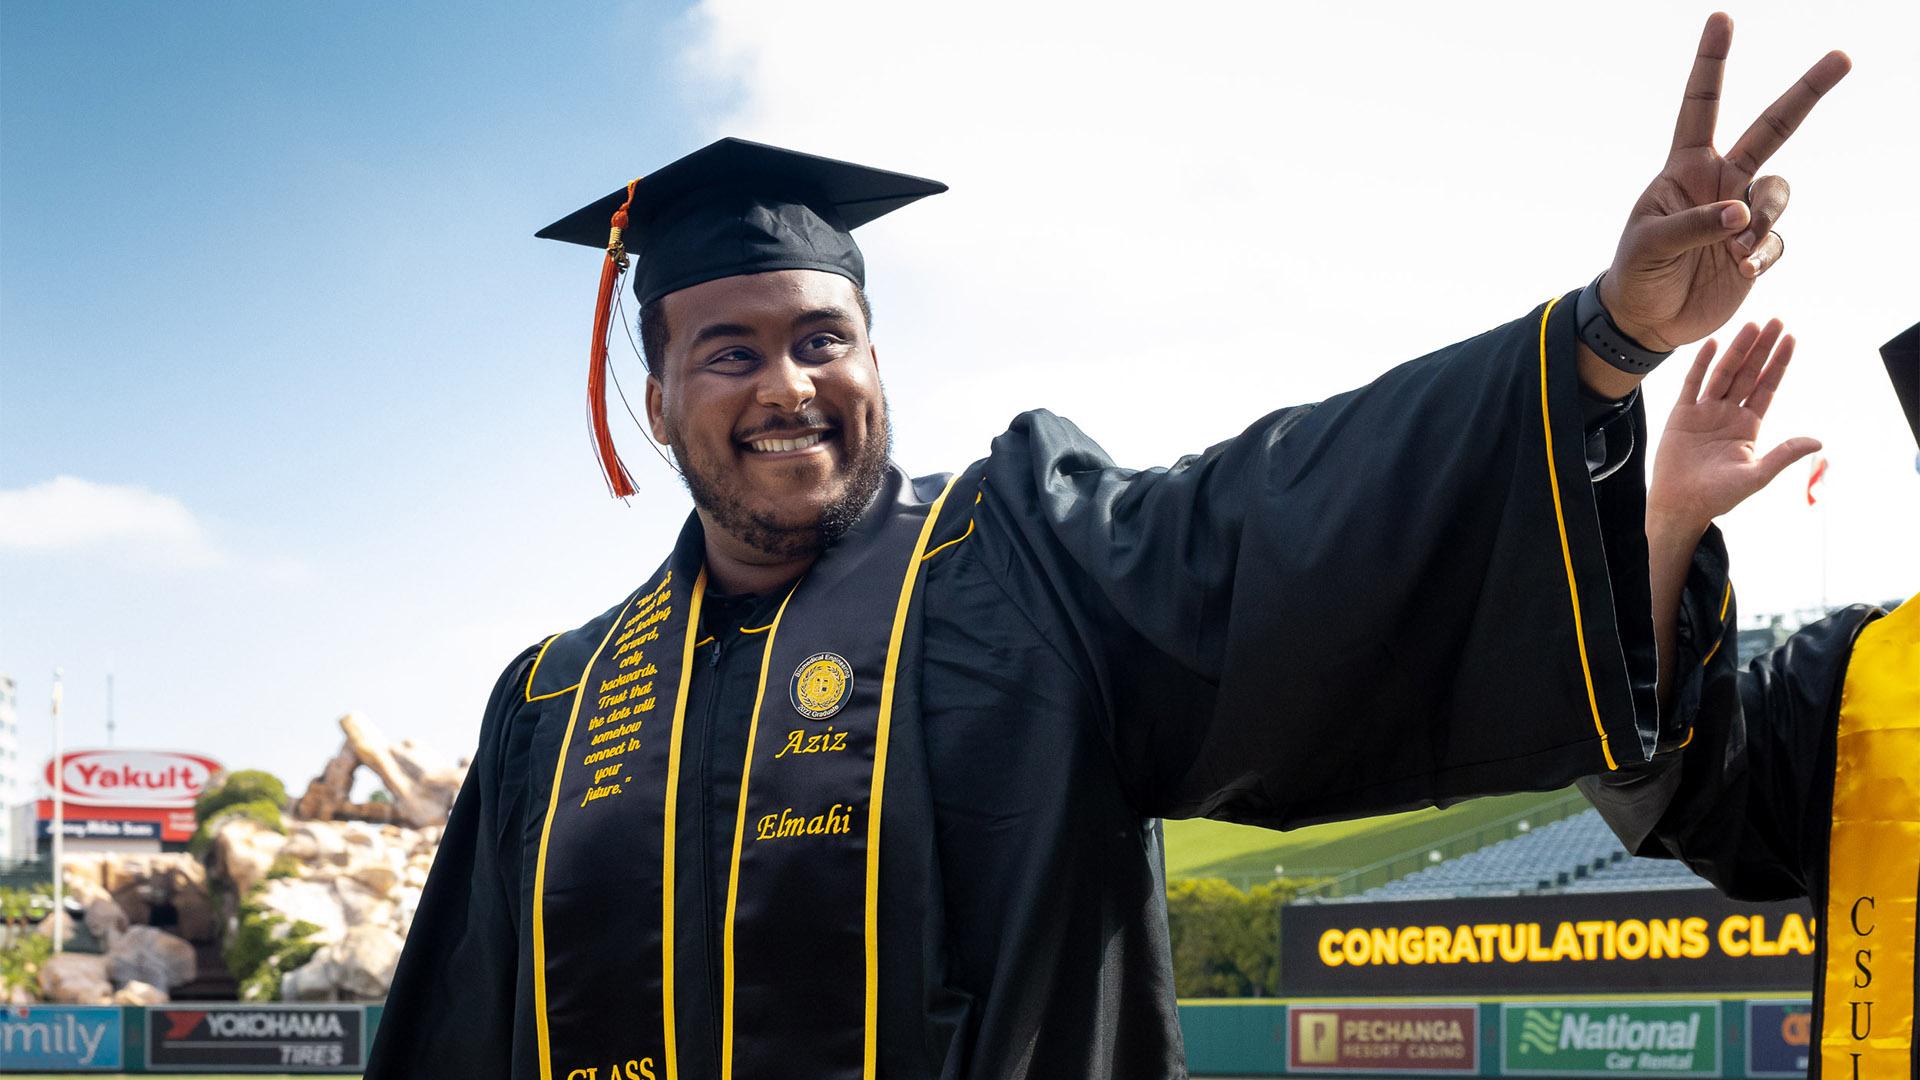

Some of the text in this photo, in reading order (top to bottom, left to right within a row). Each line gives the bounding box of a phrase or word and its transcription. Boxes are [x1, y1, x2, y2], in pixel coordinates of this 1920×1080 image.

[656, 590, 672, 606] the
[635, 606, 672, 633] looking
[612, 626, 660, 660] forward,
[619, 651, 644, 669] only
[794, 654, 824, 679] Biomedical
[599, 664, 658, 693] backwards.
[598, 681, 653, 710] Trust that
[588, 696, 657, 731] the dots will
[797, 704, 839, 718] 2022 Graduate
[591, 720, 643, 746] somehow
[775, 726, 849, 759] Aziz
[584, 738, 641, 765] connect in
[75, 763, 199, 790] Yakult
[594, 763, 623, 785] your
[756, 803, 853, 841] Elmahi
[1318, 913, 1816, 968] CONGRATULATIONS CLA
[206, 1013, 343, 1037] YOKOHAMA
[1342, 1020, 1462, 1042] PECHANGA
[1557, 1013, 1700, 1051] National
[279, 1044, 344, 1066] TIRES
[1343, 1045, 1465, 1059] RESORT CASINO
[1605, 1051, 1694, 1070] Car Rental
